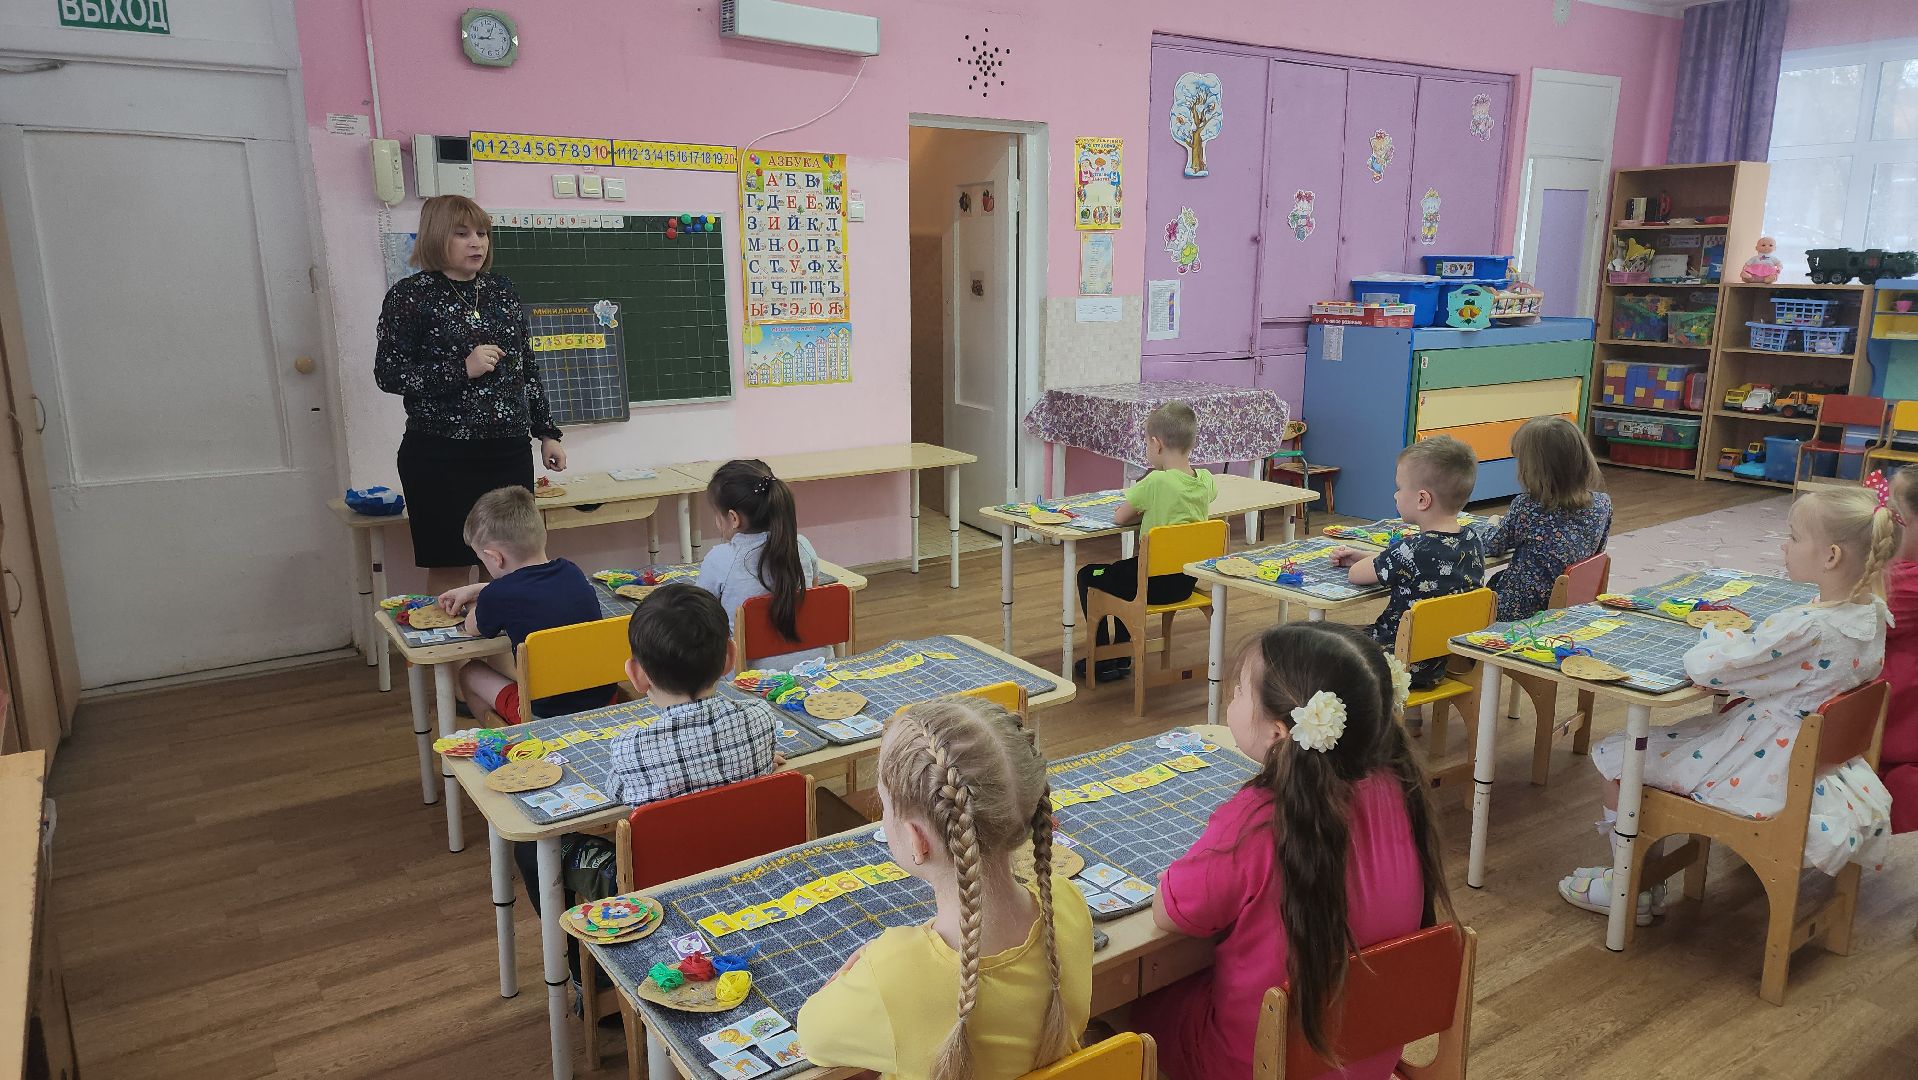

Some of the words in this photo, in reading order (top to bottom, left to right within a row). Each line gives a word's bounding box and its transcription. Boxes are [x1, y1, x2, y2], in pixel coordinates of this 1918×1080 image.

[60, 0, 168, 31] ВЫХОД
[475, 139, 485, 153] 0
[488, 139, 494, 153] 1
[498, 140, 508, 154] 2
[511, 141, 520, 155] 3
[523, 142, 531, 155] 4
[535, 142, 544, 156] 5
[547, 143, 556, 156] 6
[558, 143, 567, 157] 7
[571, 144, 580, 158] 8
[582, 144, 591, 158] 9
[593, 145, 609, 159] 10
[617, 147, 626, 160] 11
[628, 148, 638, 161] 12
[640, 149, 651, 161] 13
[653, 149, 663, 161] 14
[665, 150, 676, 162] 15
[677, 150, 688, 163] 16
[690, 151, 699, 164] 17
[701, 152, 711, 164] 18
[713, 152, 723, 165] 19
[724, 153, 735, 165] 20
[768, 155, 821, 168] АЗБУКА
[766, 173, 779, 186] А
[785, 173, 796, 187] Б
[805, 174, 816, 188] В
[746, 193, 756, 207] Г
[766, 194, 779, 211] Д
[786, 195, 797, 208] Е
[806, 194, 817, 210] Ё
[825, 196, 839, 210] Ж
[500, 216, 506, 224] 3
[511, 216, 517, 225] 4
[523, 217, 529, 225] 5
[536, 217, 542, 225] 6
[547, 217, 553, 225] 7
[559, 217, 565, 225] 8
[747, 216, 757, 230] З
[768, 216, 780, 230] И
[787, 215, 800, 231] Й
[806, 217, 819, 231] К
[826, 217, 838, 231] Л
[748, 238, 760, 252] М
[768, 238, 781, 252] Н
[787, 238, 799, 252] О
[807, 239, 819, 252] П
[826, 239, 836, 252] Р
[749, 259, 760, 274] С
[769, 259, 780, 273] Т
[789, 259, 801, 273] У
[807, 259, 821, 273] Ф
[827, 259, 839, 273] Х
[750, 281, 764, 297] Ц
[771, 281, 783, 294] Ч
[790, 281, 804, 294] Ш
[809, 280, 825, 297] Щ
[828, 280, 841, 294] Ъ
[750, 303, 764, 316] Ы
[771, 303, 781, 316] Ь
[789, 302, 800, 315] Э
[809, 302, 823, 316] Ю
[828, 302, 839, 315] Я
